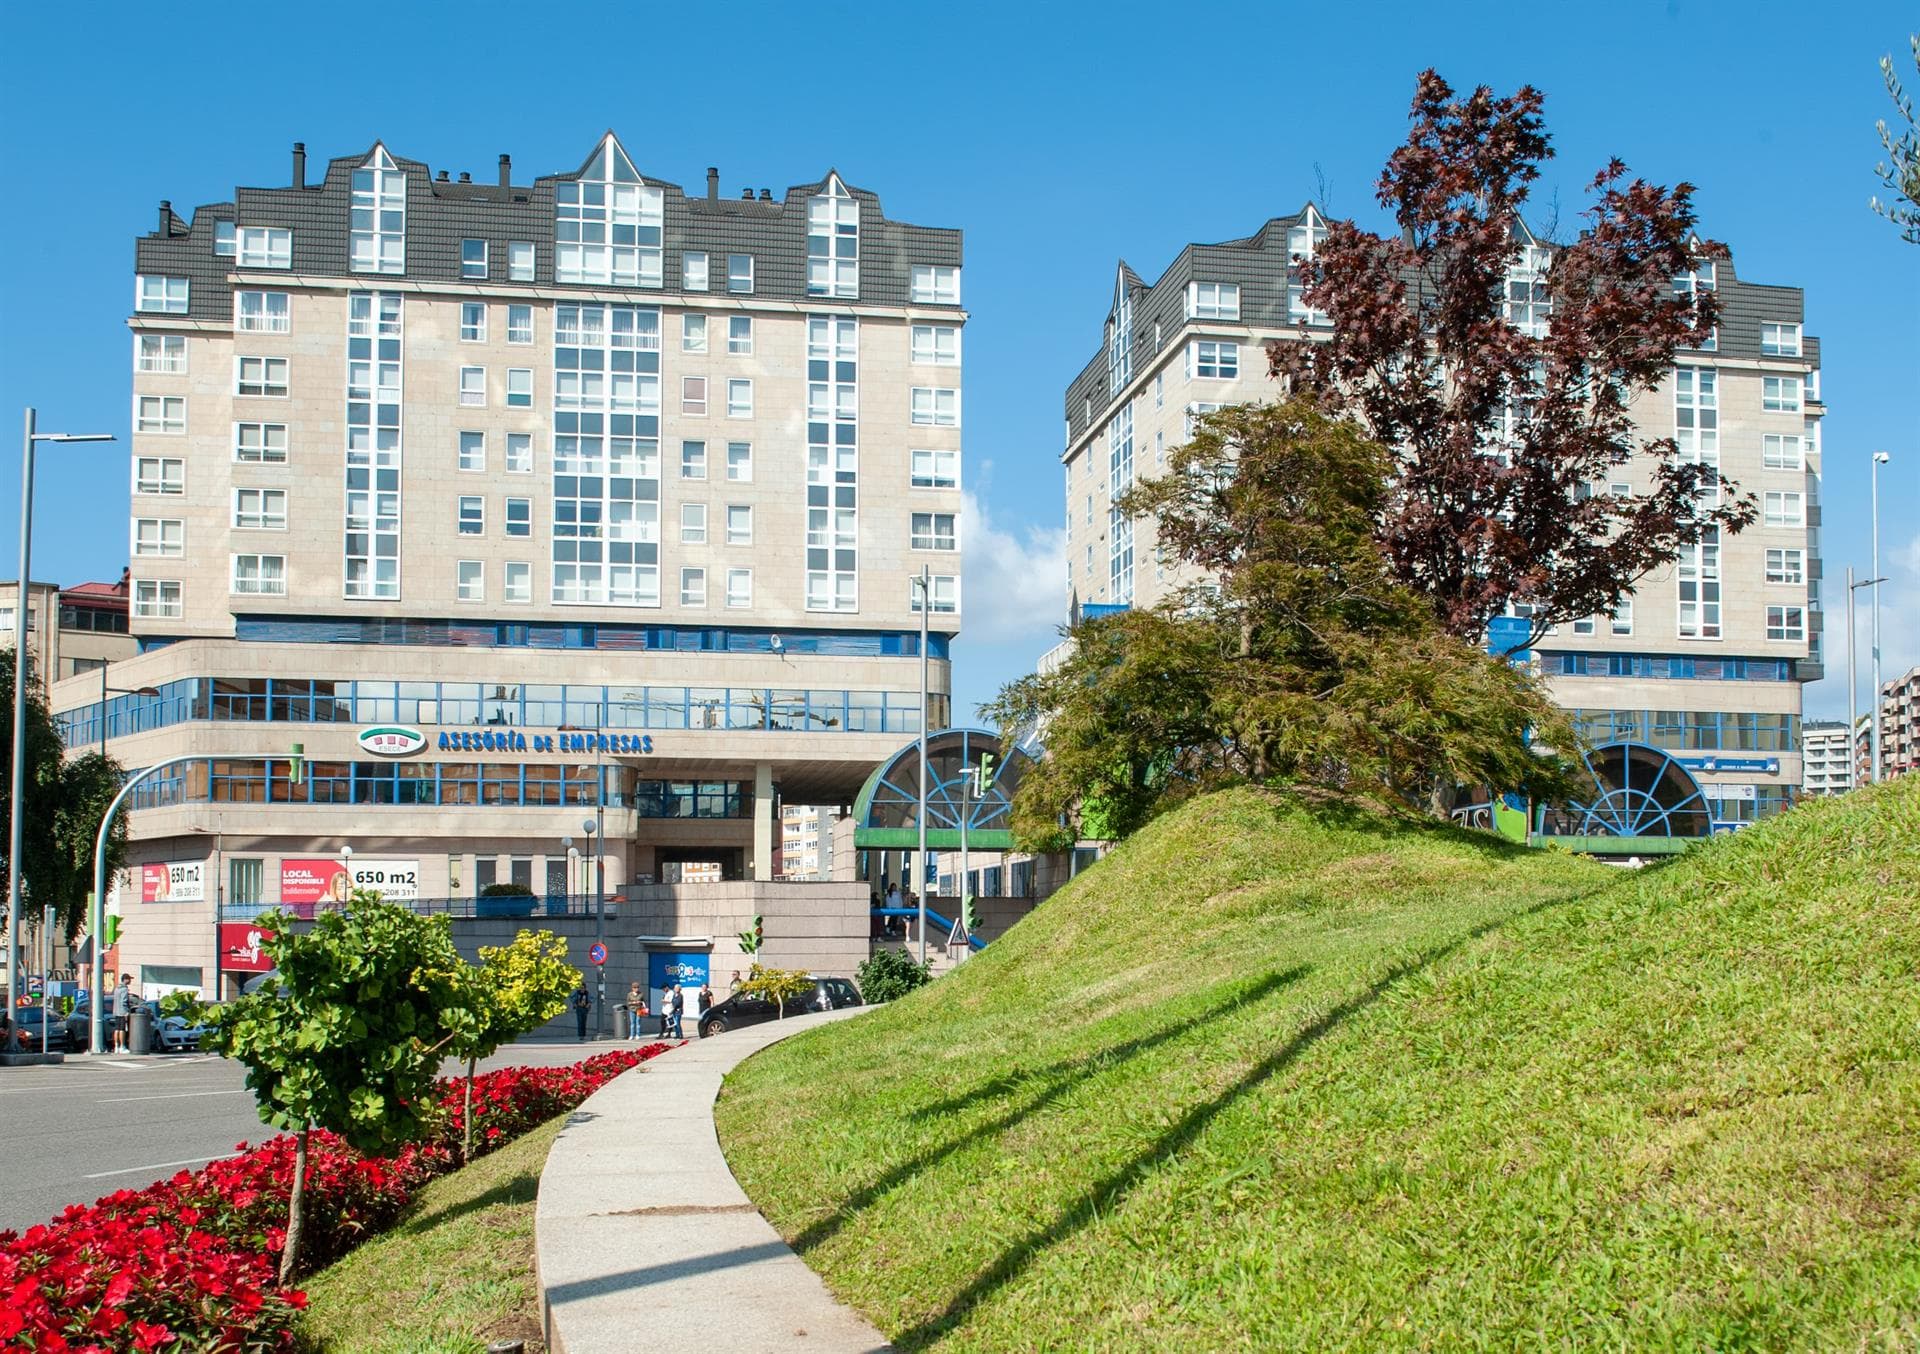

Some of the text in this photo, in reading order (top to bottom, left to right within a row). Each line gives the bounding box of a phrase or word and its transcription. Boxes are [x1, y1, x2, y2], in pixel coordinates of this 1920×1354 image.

[534, 736, 553, 751] DE
[559, 734, 653, 752] EMPRESAS
[171, 866, 200, 883] 650 m2
[283, 870, 313, 878] LOCAL
[356, 871, 416, 884] 650 m2
